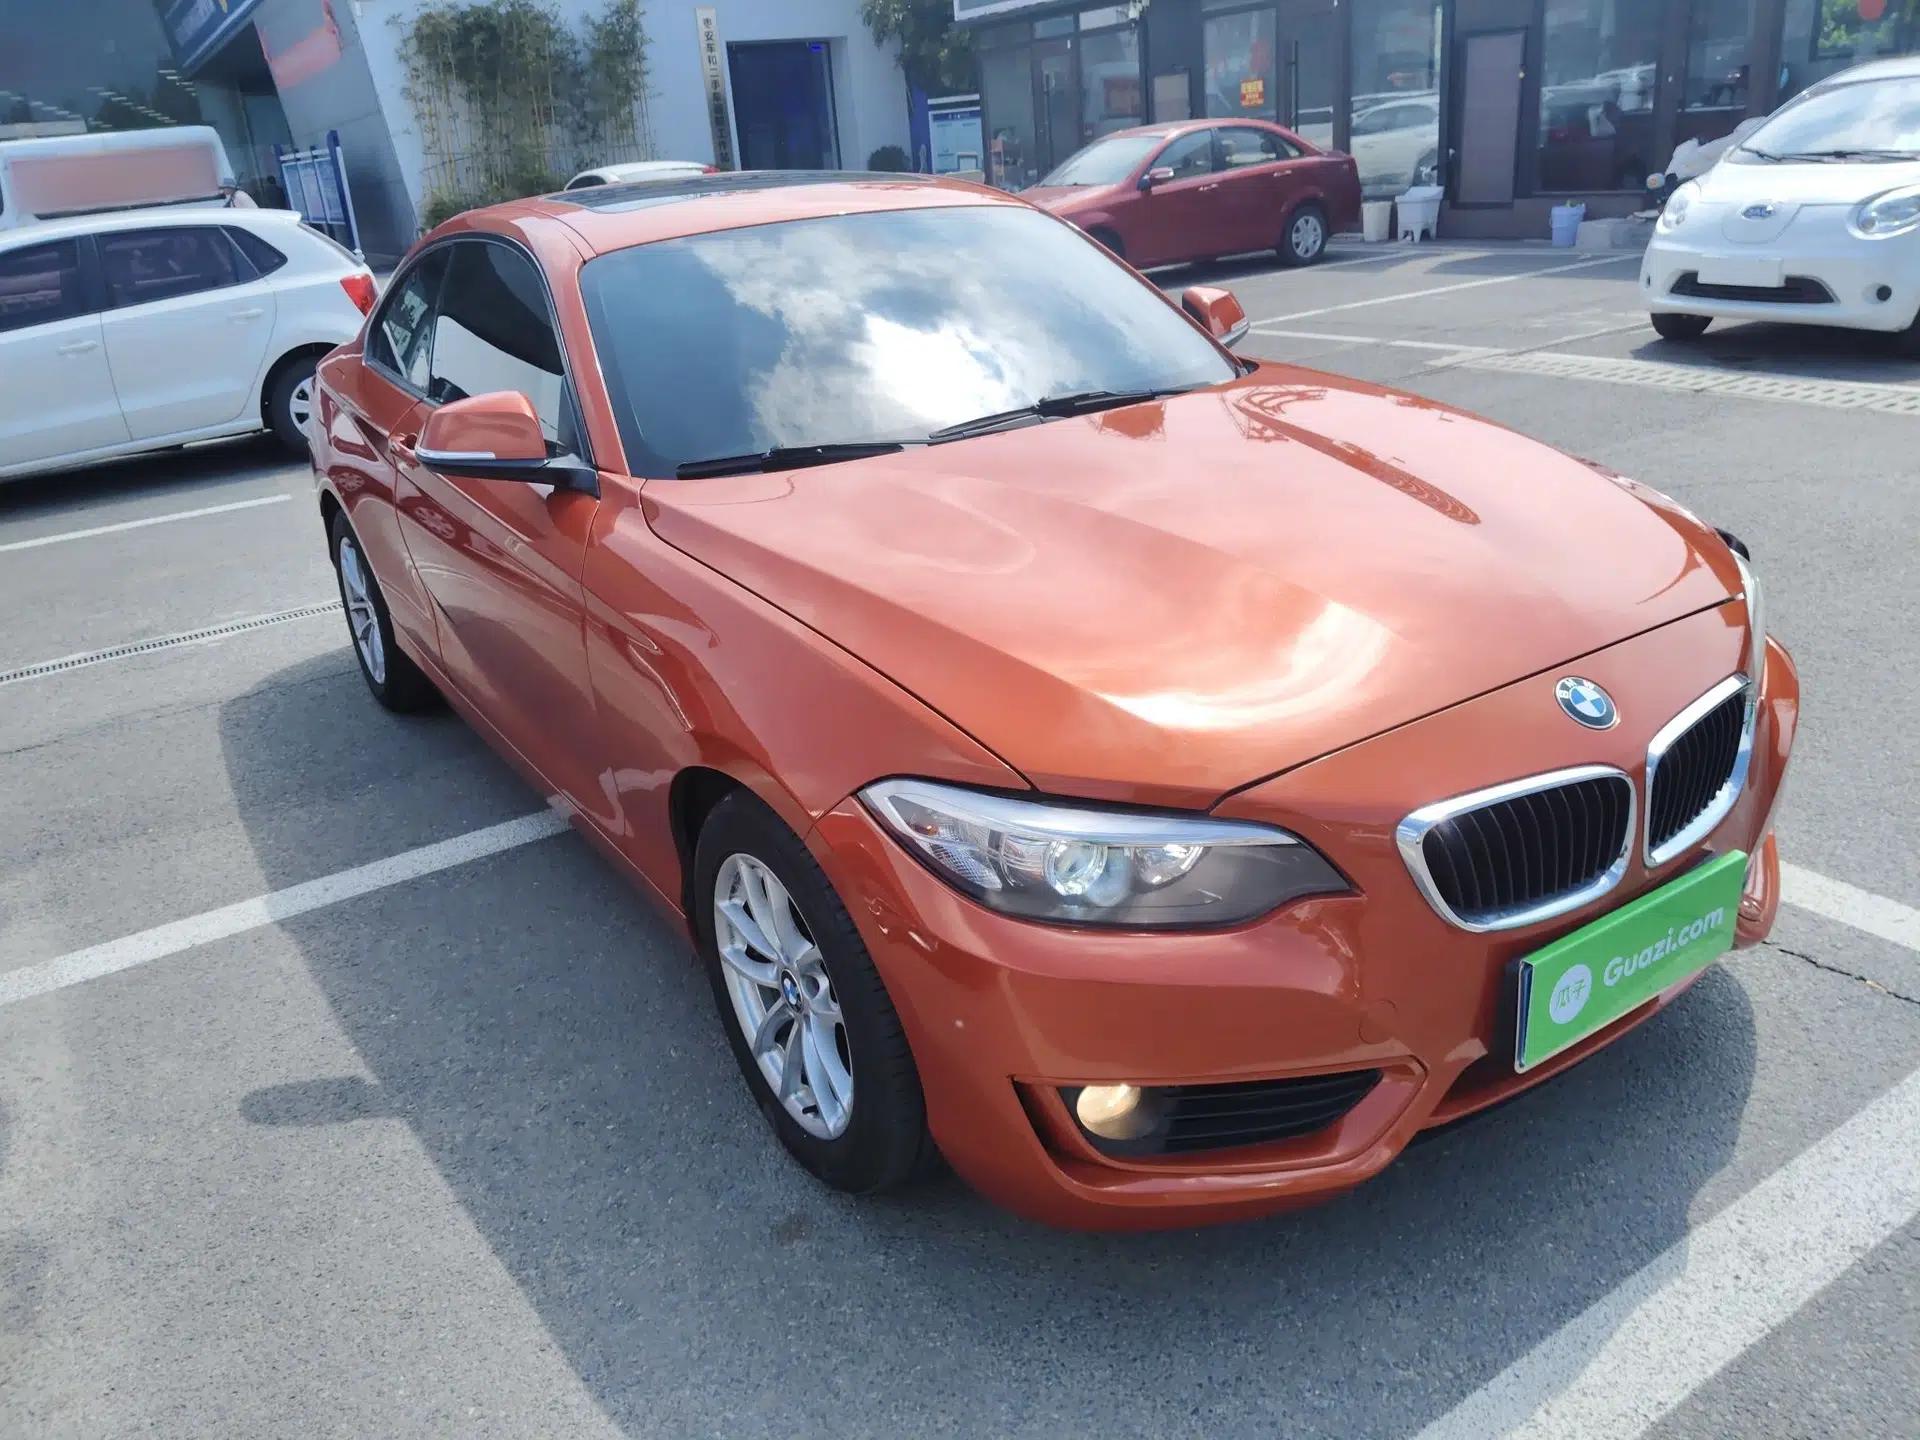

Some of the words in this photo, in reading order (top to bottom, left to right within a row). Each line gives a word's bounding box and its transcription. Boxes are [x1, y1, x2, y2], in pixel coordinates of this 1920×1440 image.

[1558, 679, 1595, 699] BMW
[1603, 907, 1724, 987] Guazi.com
[1554, 978, 1586, 1009] 瓜子
